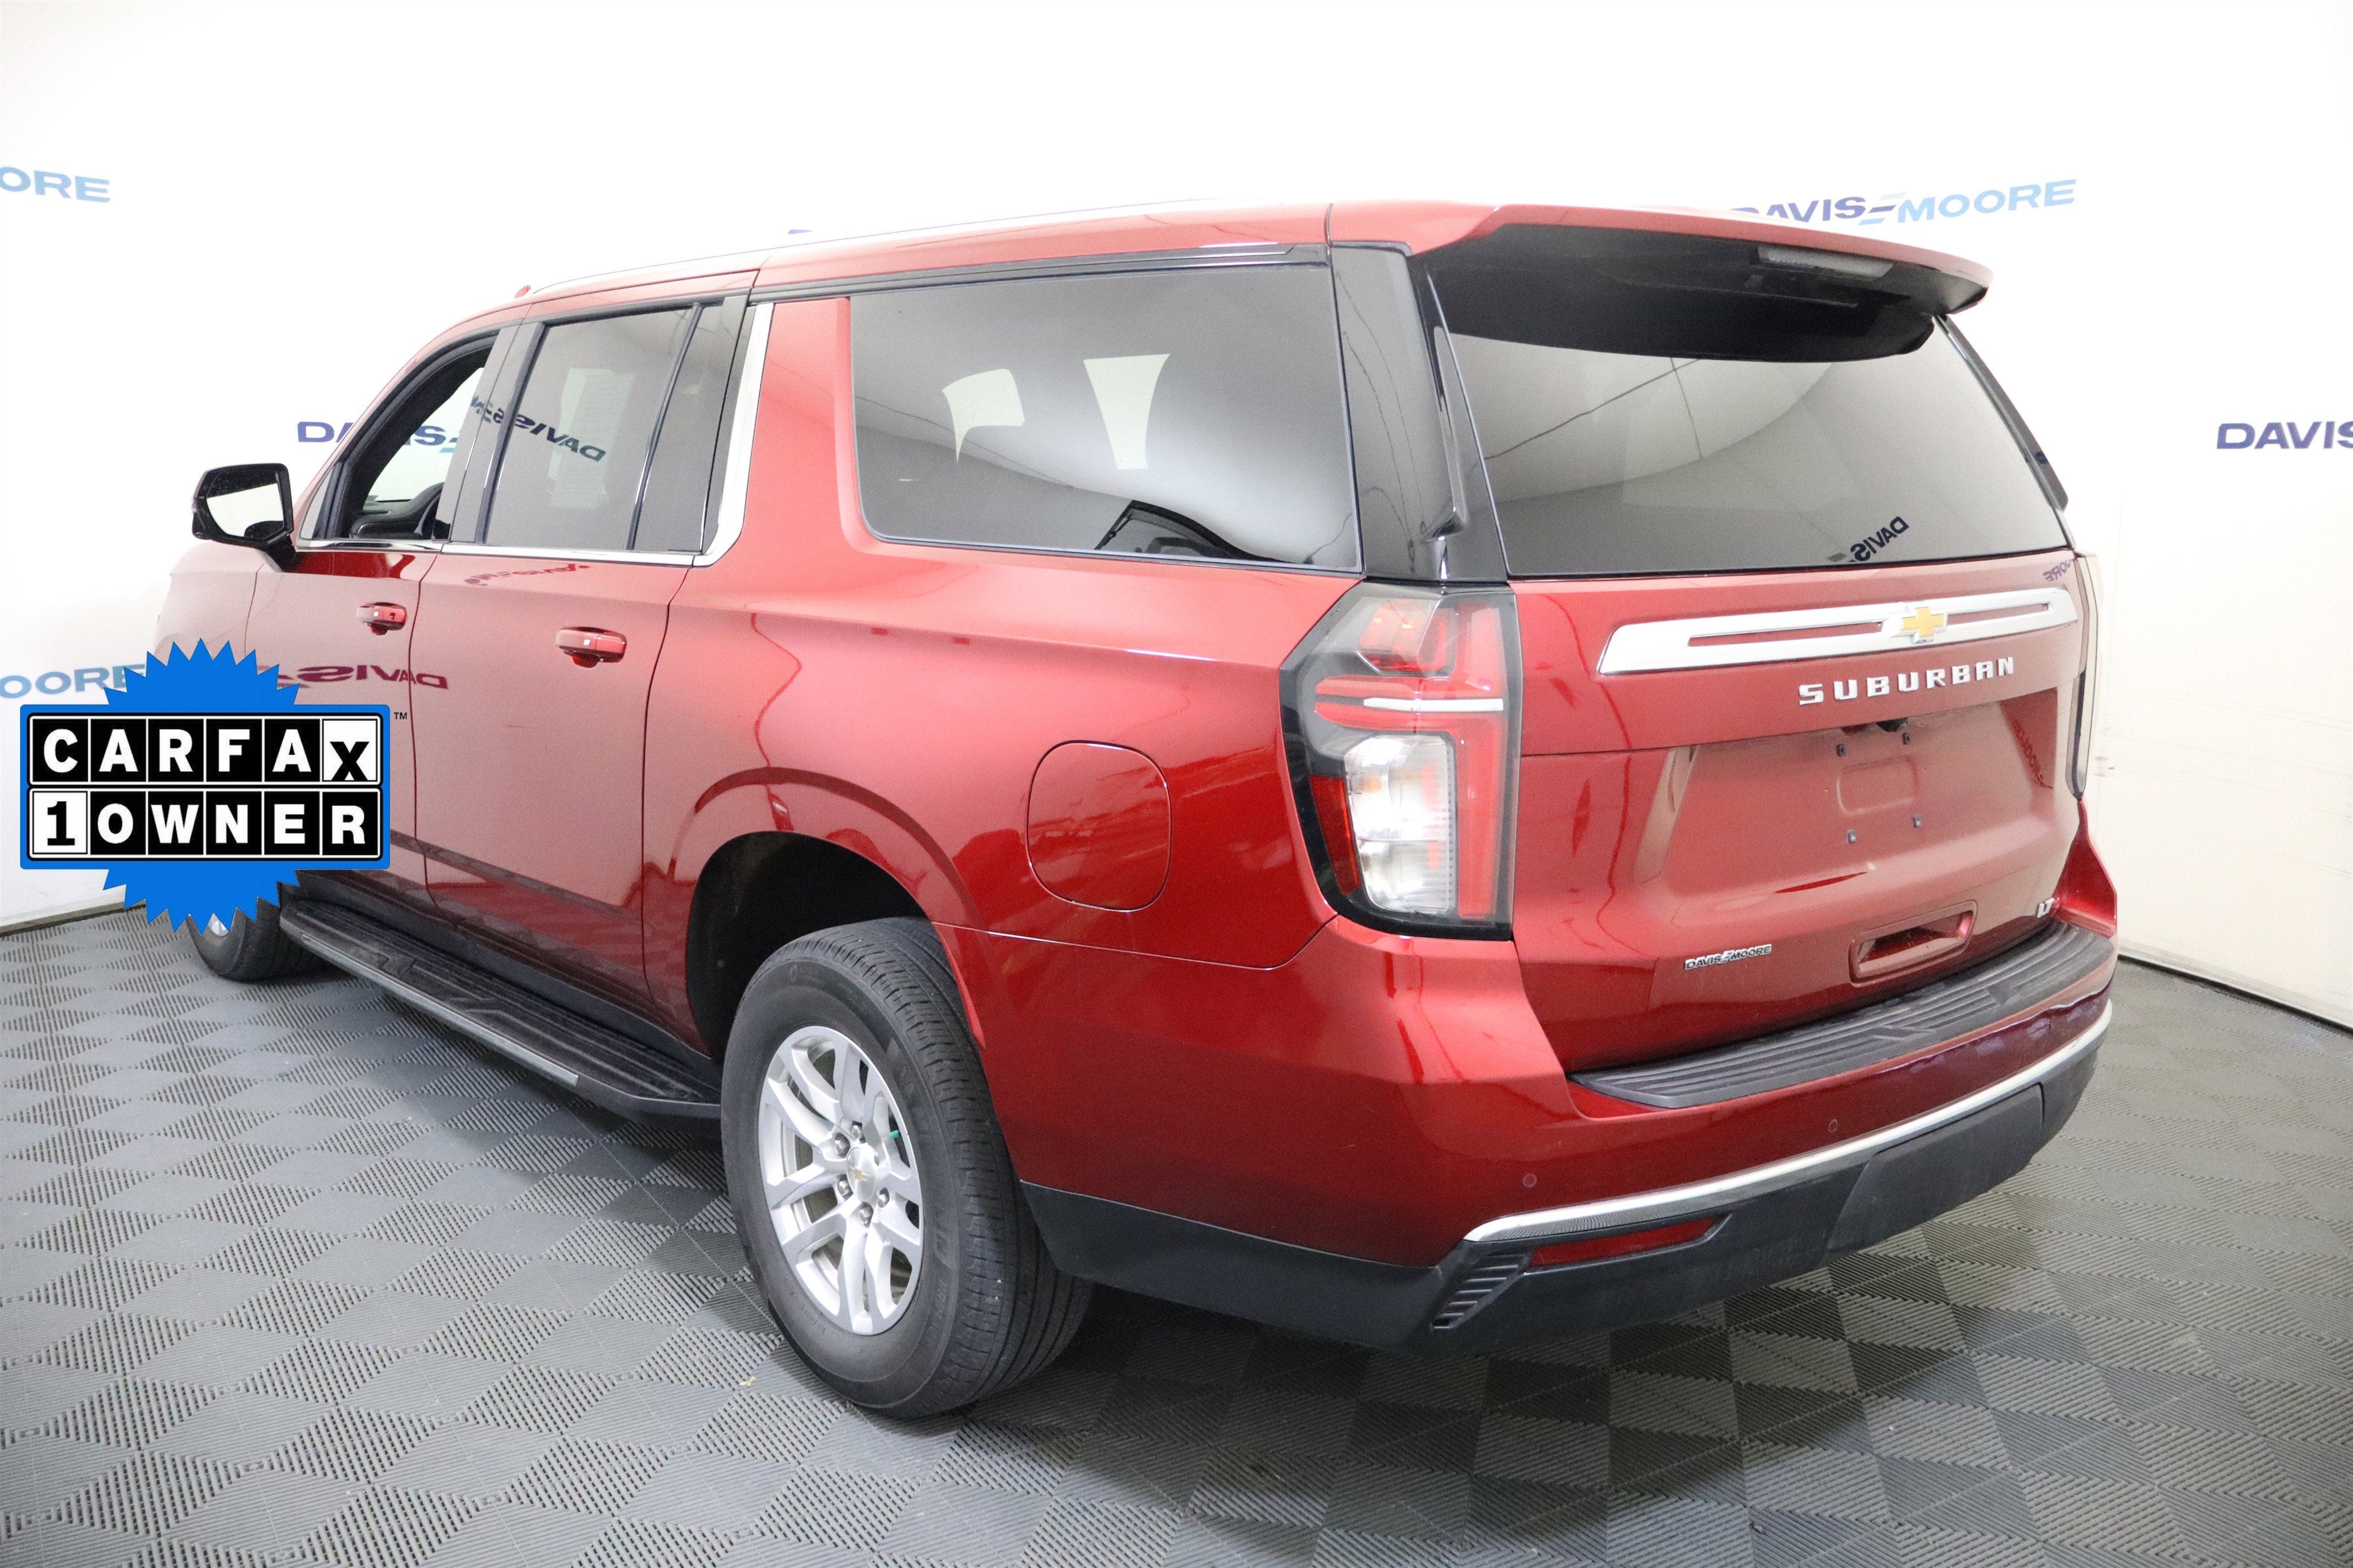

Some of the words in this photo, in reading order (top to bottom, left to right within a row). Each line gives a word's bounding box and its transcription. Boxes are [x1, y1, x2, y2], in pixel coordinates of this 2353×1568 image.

[1730, 196, 1866, 223] AVIS
[1897, 179, 2076, 223] MOORE
[1799, 656, 2014, 705] SUBURBAN
[2036, 898, 2055, 918] LT
